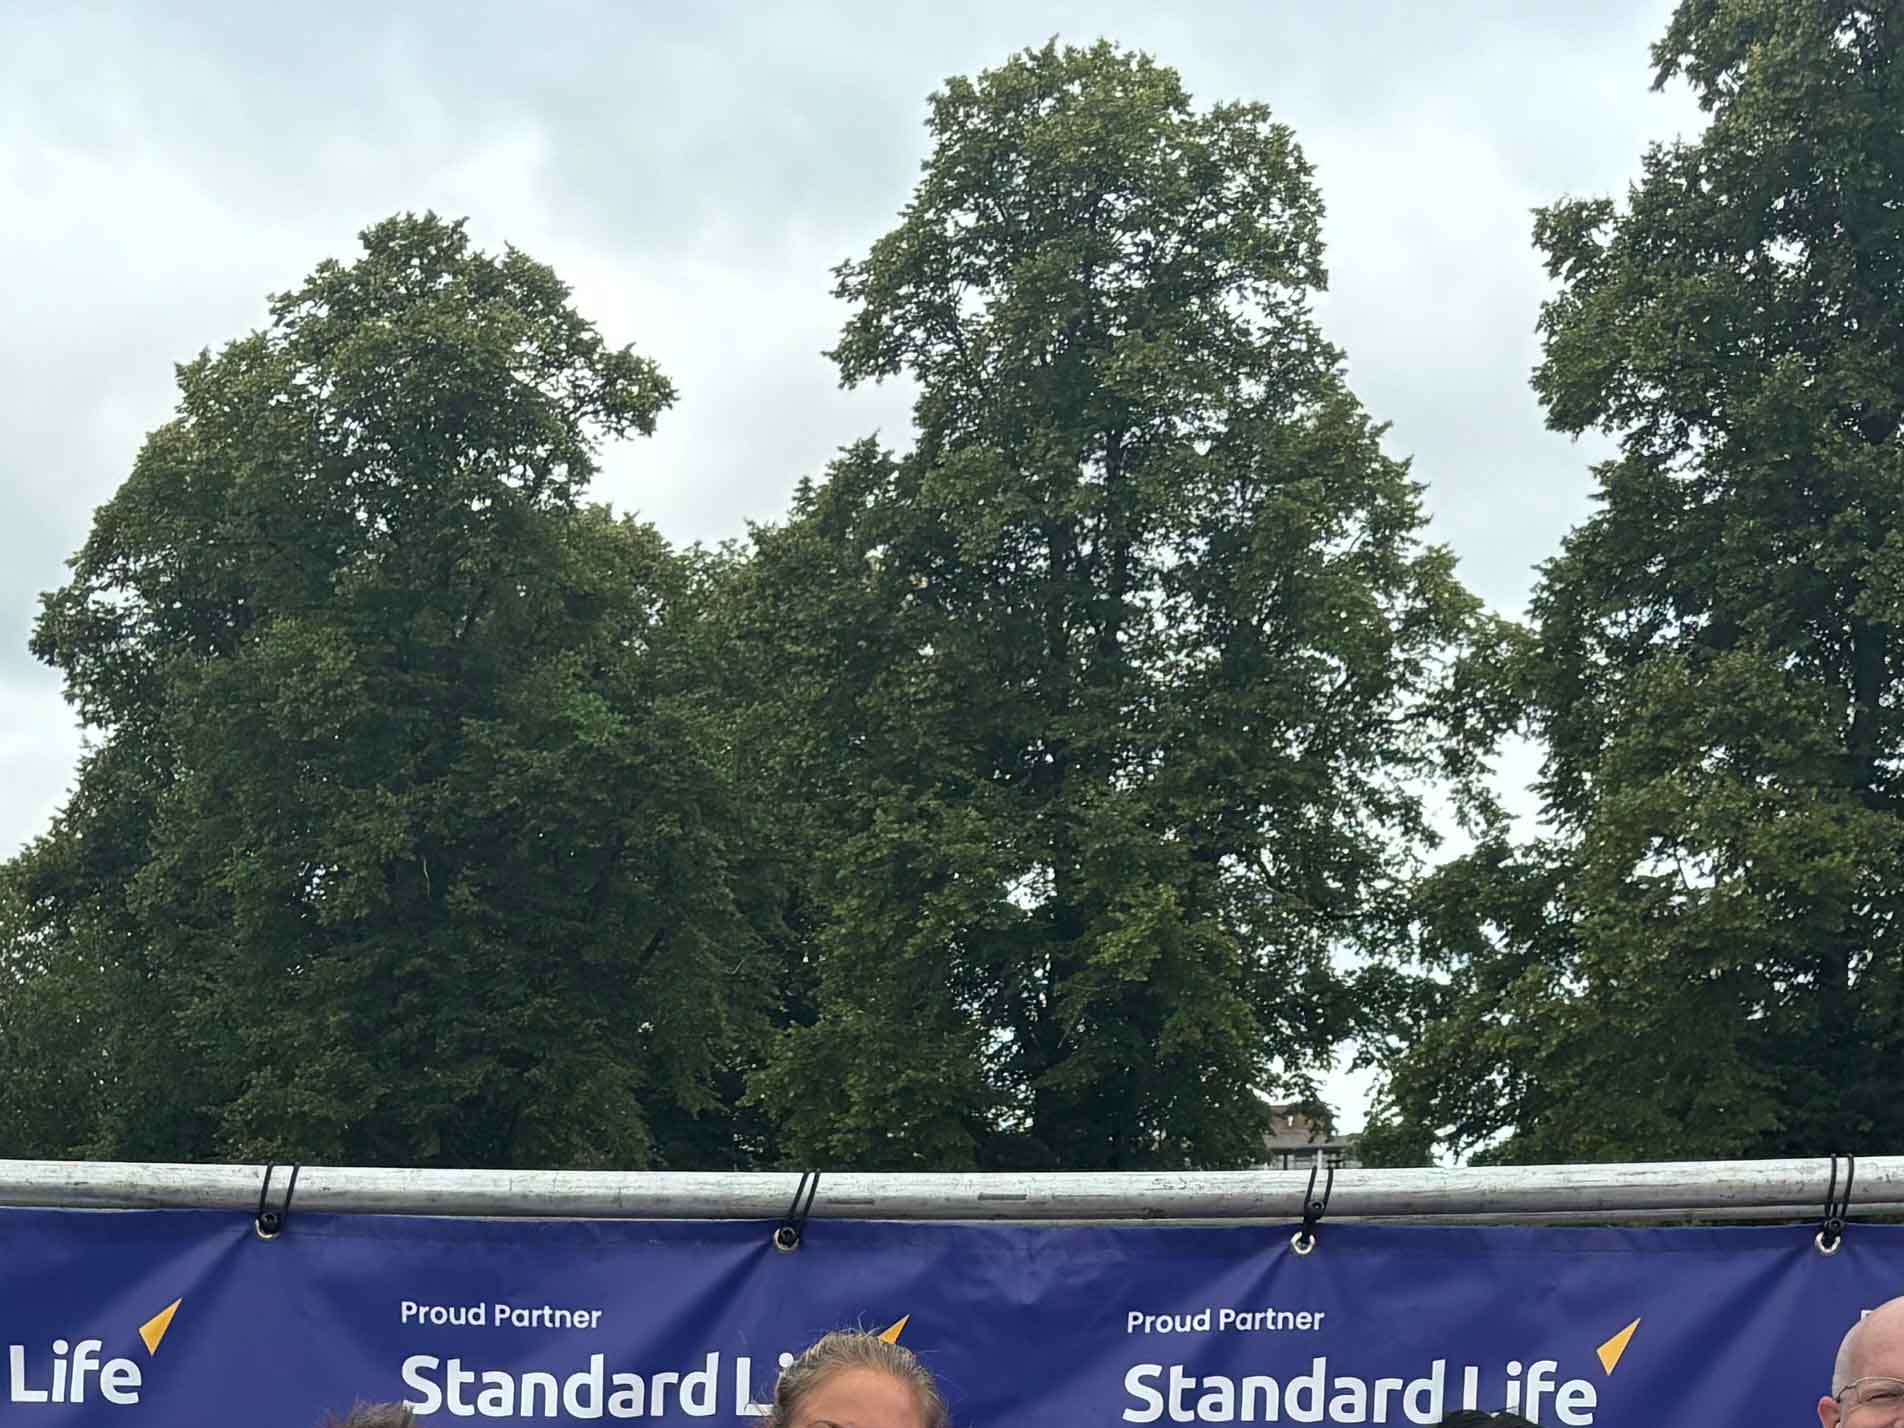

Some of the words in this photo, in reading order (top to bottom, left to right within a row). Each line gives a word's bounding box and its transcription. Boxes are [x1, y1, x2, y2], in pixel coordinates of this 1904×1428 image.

[400, 1301, 486, 1325] Proud
[494, 1303, 602, 1329] Partner
[1127, 1308, 1211, 1333] Proud
[1219, 1307, 1325, 1332] Partner
[9, 1338, 143, 1404] Life
[401, 1351, 720, 1418] Standard
[1122, 1356, 1446, 1424] Standard
[1462, 1359, 1598, 1427] Life
